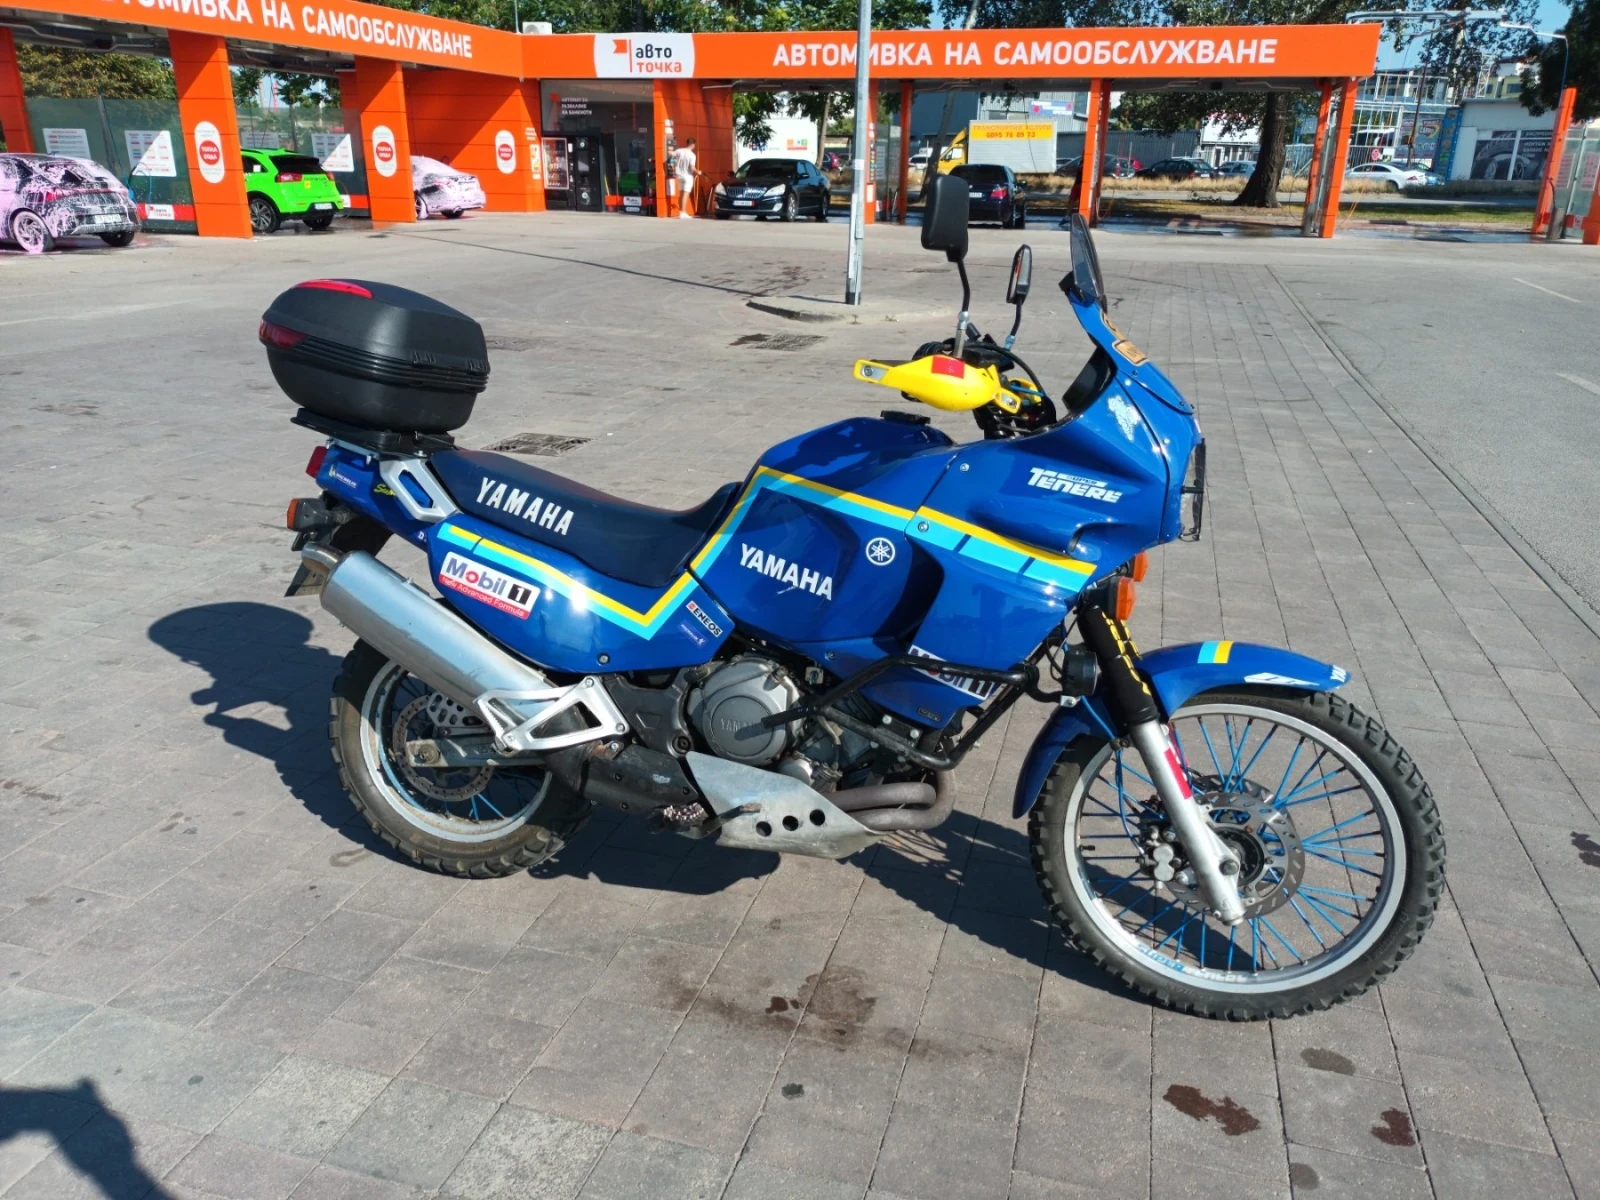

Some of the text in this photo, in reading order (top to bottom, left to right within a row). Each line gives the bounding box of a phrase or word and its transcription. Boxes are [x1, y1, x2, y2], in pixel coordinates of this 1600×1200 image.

[258, 0, 296, 31] НА
[301, 5, 473, 59] САМООБСЛУЖВАНЕ
[635, 43, 672, 59] авто
[636, 61, 682, 73] точка
[772, 39, 1278, 67] АВТОМИВКА НА САМООБСЛУЖВАНЕ
[476, 476, 574, 536] YAMAHA
[446, 557, 508, 596] Mobil
[740, 543, 832, 601] YAMAHA
[442, 576, 524, 616] New Advanced Formula
[694, 608, 721, 636] ENEOS
